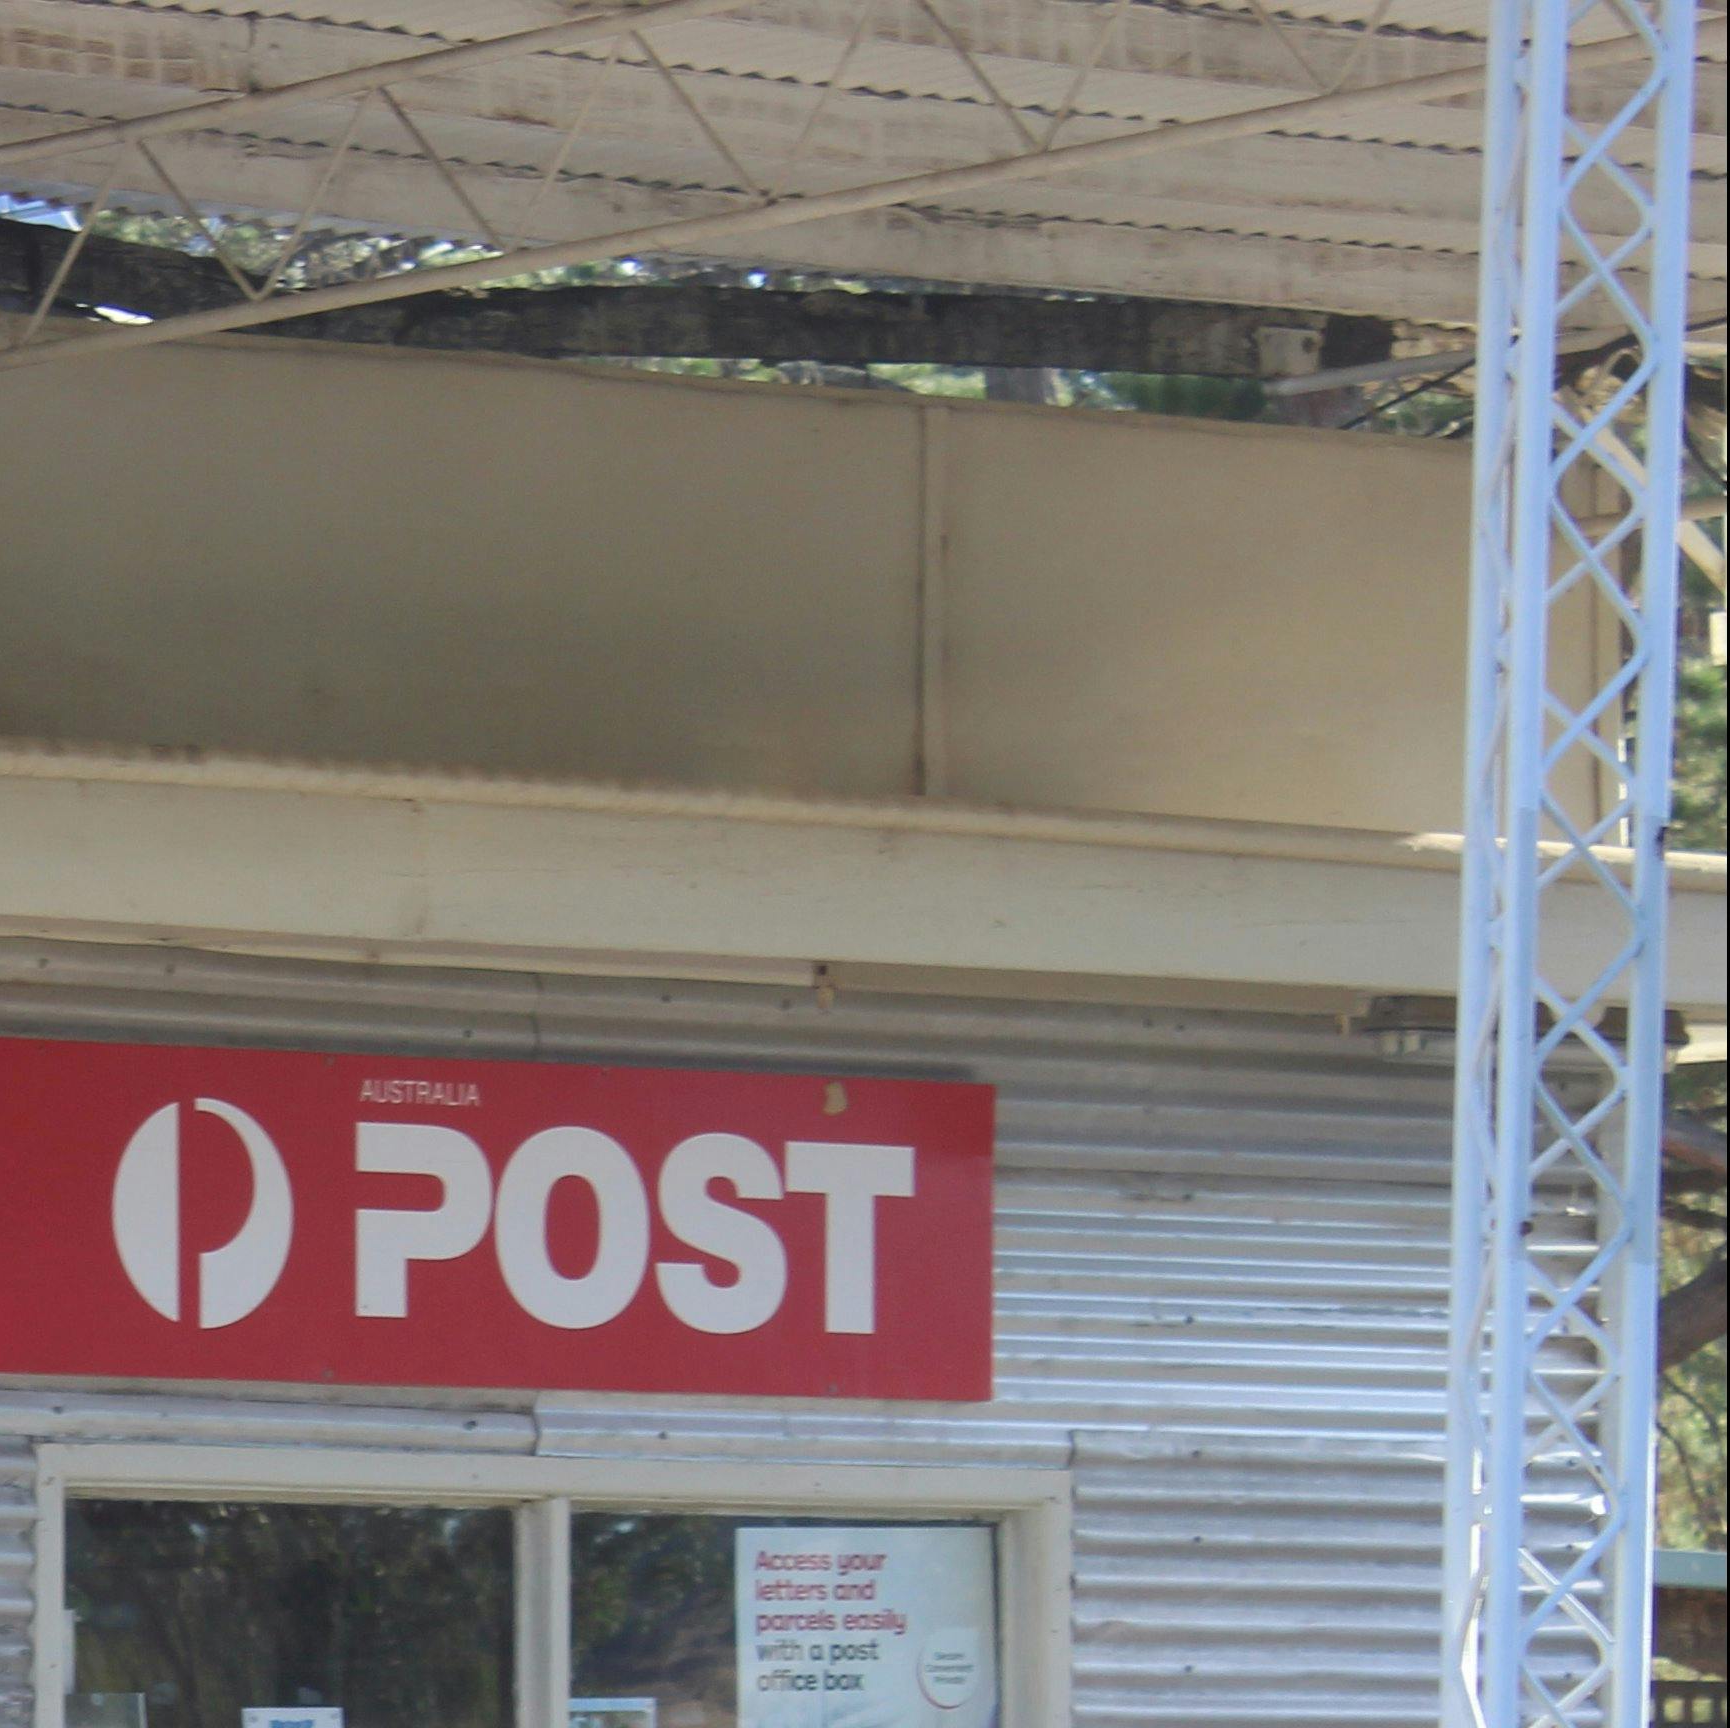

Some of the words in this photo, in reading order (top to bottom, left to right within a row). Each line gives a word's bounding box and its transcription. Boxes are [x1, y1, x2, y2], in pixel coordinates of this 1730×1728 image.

[360, 1079, 480, 1106] AUSTRALIA
[355, 1122, 915, 1334] POST
[755, 1551, 833, 1571] Access
[837, 1554, 888, 1576] your
[755, 1579, 828, 1601] letters
[833, 1579, 876, 1600] and
[755, 1609, 837, 1635] parcels
[843, 1607, 907, 1636] easily
[755, 1639, 803, 1661] with
[809, 1644, 824, 1661] a
[830, 1638, 880, 1665] post
[757, 1669, 818, 1692] office
[824, 1668, 865, 1692] box
